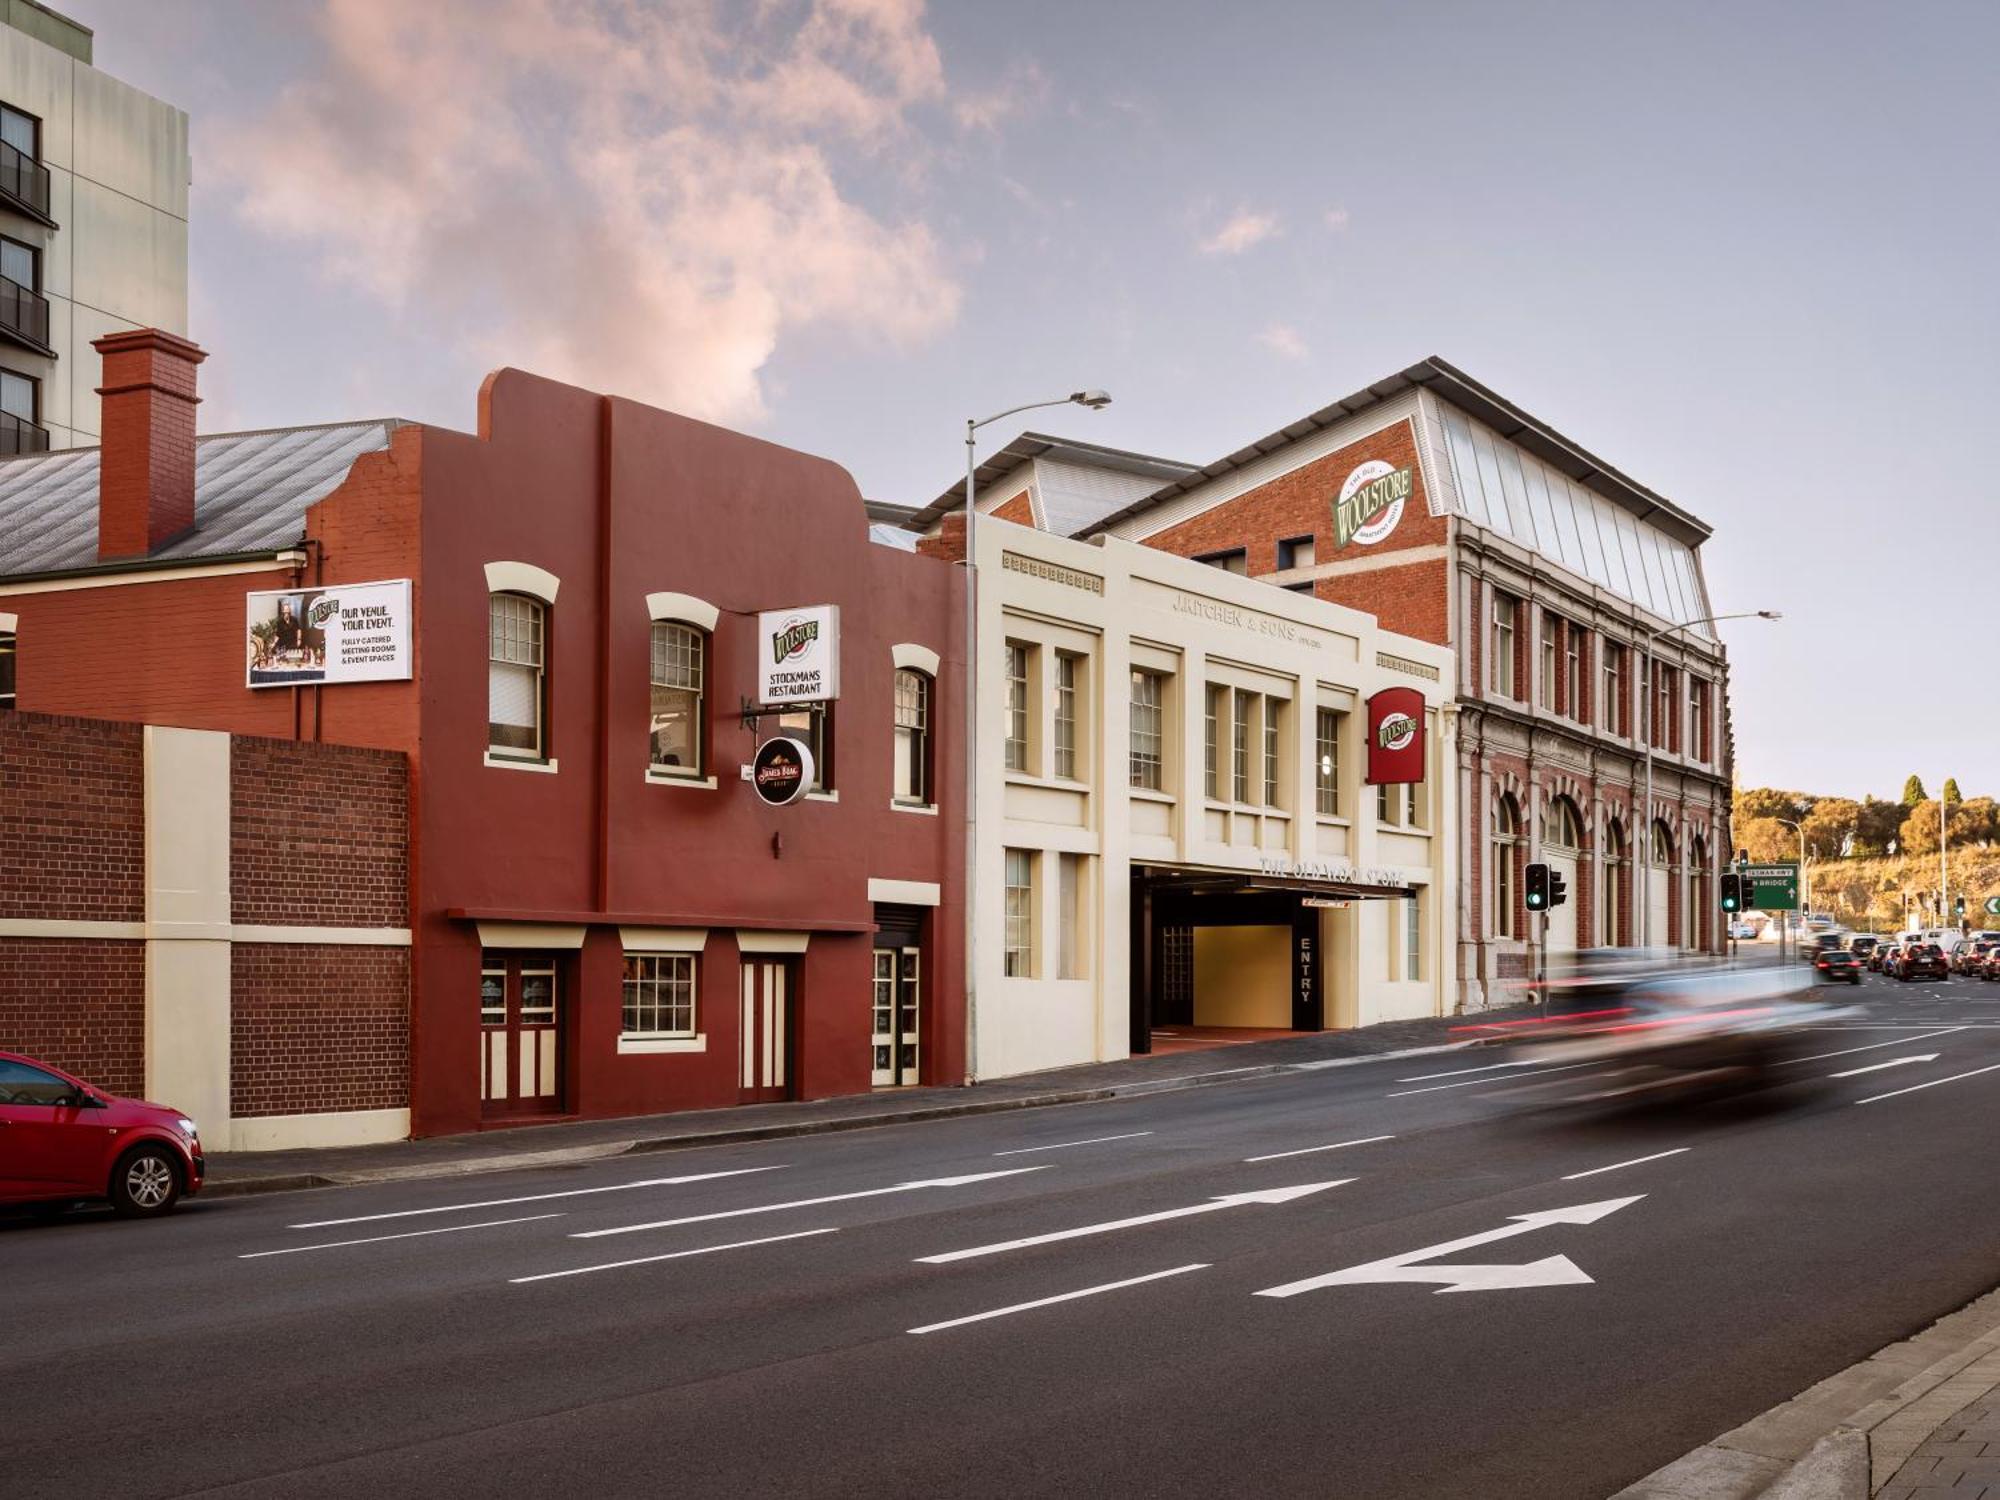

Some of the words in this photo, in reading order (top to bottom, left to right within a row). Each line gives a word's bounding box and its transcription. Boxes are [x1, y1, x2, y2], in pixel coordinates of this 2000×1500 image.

[1337, 469, 1409, 545] WOOLSTORE
[342, 608, 358, 619] OUR
[361, 605, 390, 617] VENUE.
[342, 620, 364, 631] YOUR
[366, 617, 395, 629] EVENT.
[1247, 618, 1257, 632] &
[1259, 620, 1296, 641] SONS
[342, 638, 360, 646] FULLY
[361, 635, 391, 644] CATERED
[342, 647, 370, 655] MEETING
[372, 645, 396, 653] ROOMS
[348, 656, 368, 664] EVENT
[369, 654, 395, 663] SPACES
[770, 670, 821, 685] STOCKMANS
[769, 682, 822, 697] RESTAURANT
[1301, 938, 1312, 1002] ENTRY
